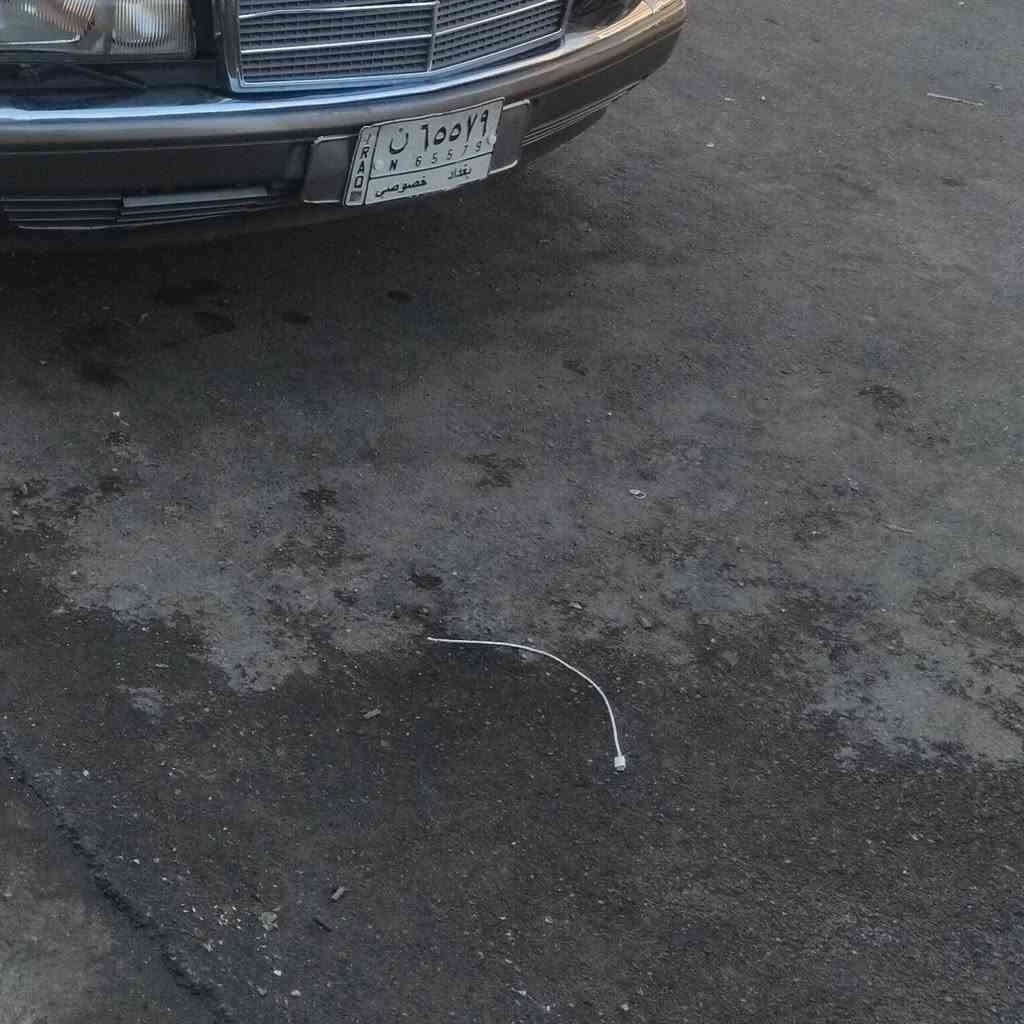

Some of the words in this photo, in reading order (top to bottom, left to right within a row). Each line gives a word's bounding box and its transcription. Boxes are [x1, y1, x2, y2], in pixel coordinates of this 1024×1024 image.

[389, 127, 409, 155] ن
[420, 109, 489, 152] ٦٥٥٧٩
[389, 159, 399, 171] N
[415, 140, 483, 168] 65579
[447, 163, 473, 180] بغداد
[376, 175, 429, 199] خصوصي
